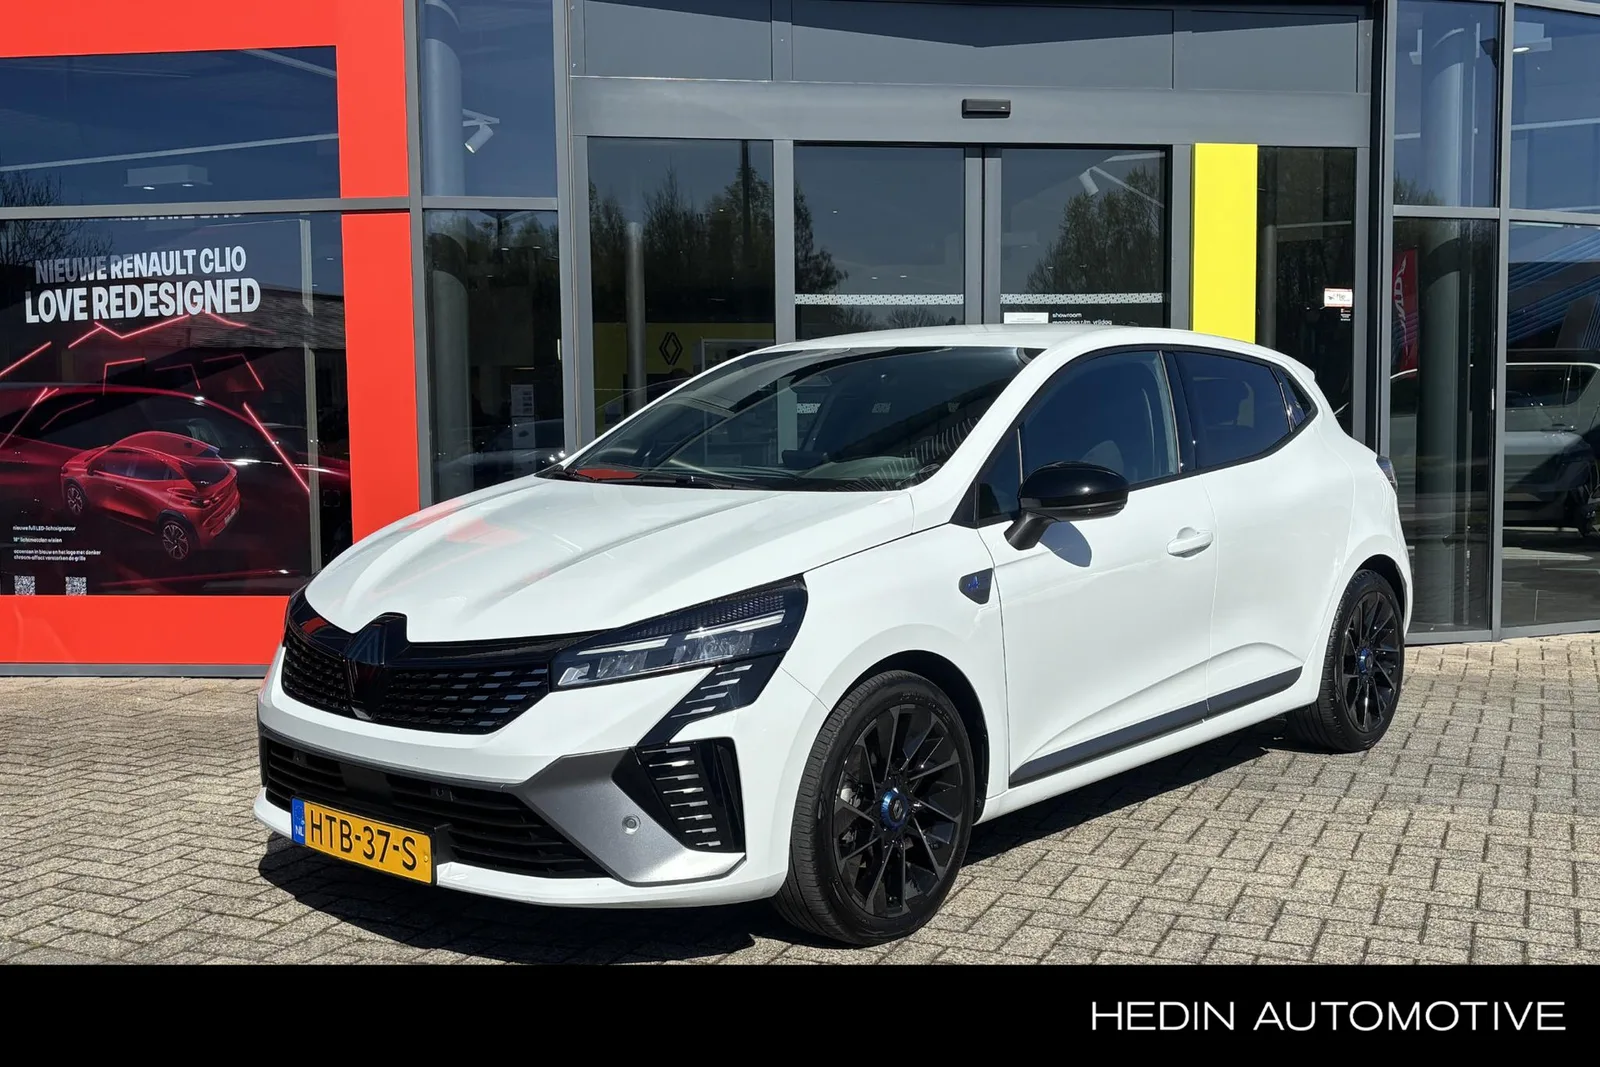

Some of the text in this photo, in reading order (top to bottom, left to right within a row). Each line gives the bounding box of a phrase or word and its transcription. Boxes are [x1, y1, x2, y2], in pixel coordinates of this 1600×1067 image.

[35, 245, 247, 284] NIEUWE RENAULT CLIO
[25, 277, 261, 324] LOVE REDESIGNED
[295, 825, 305, 837] NL
[310, 809, 418, 871] HTB-37-S
